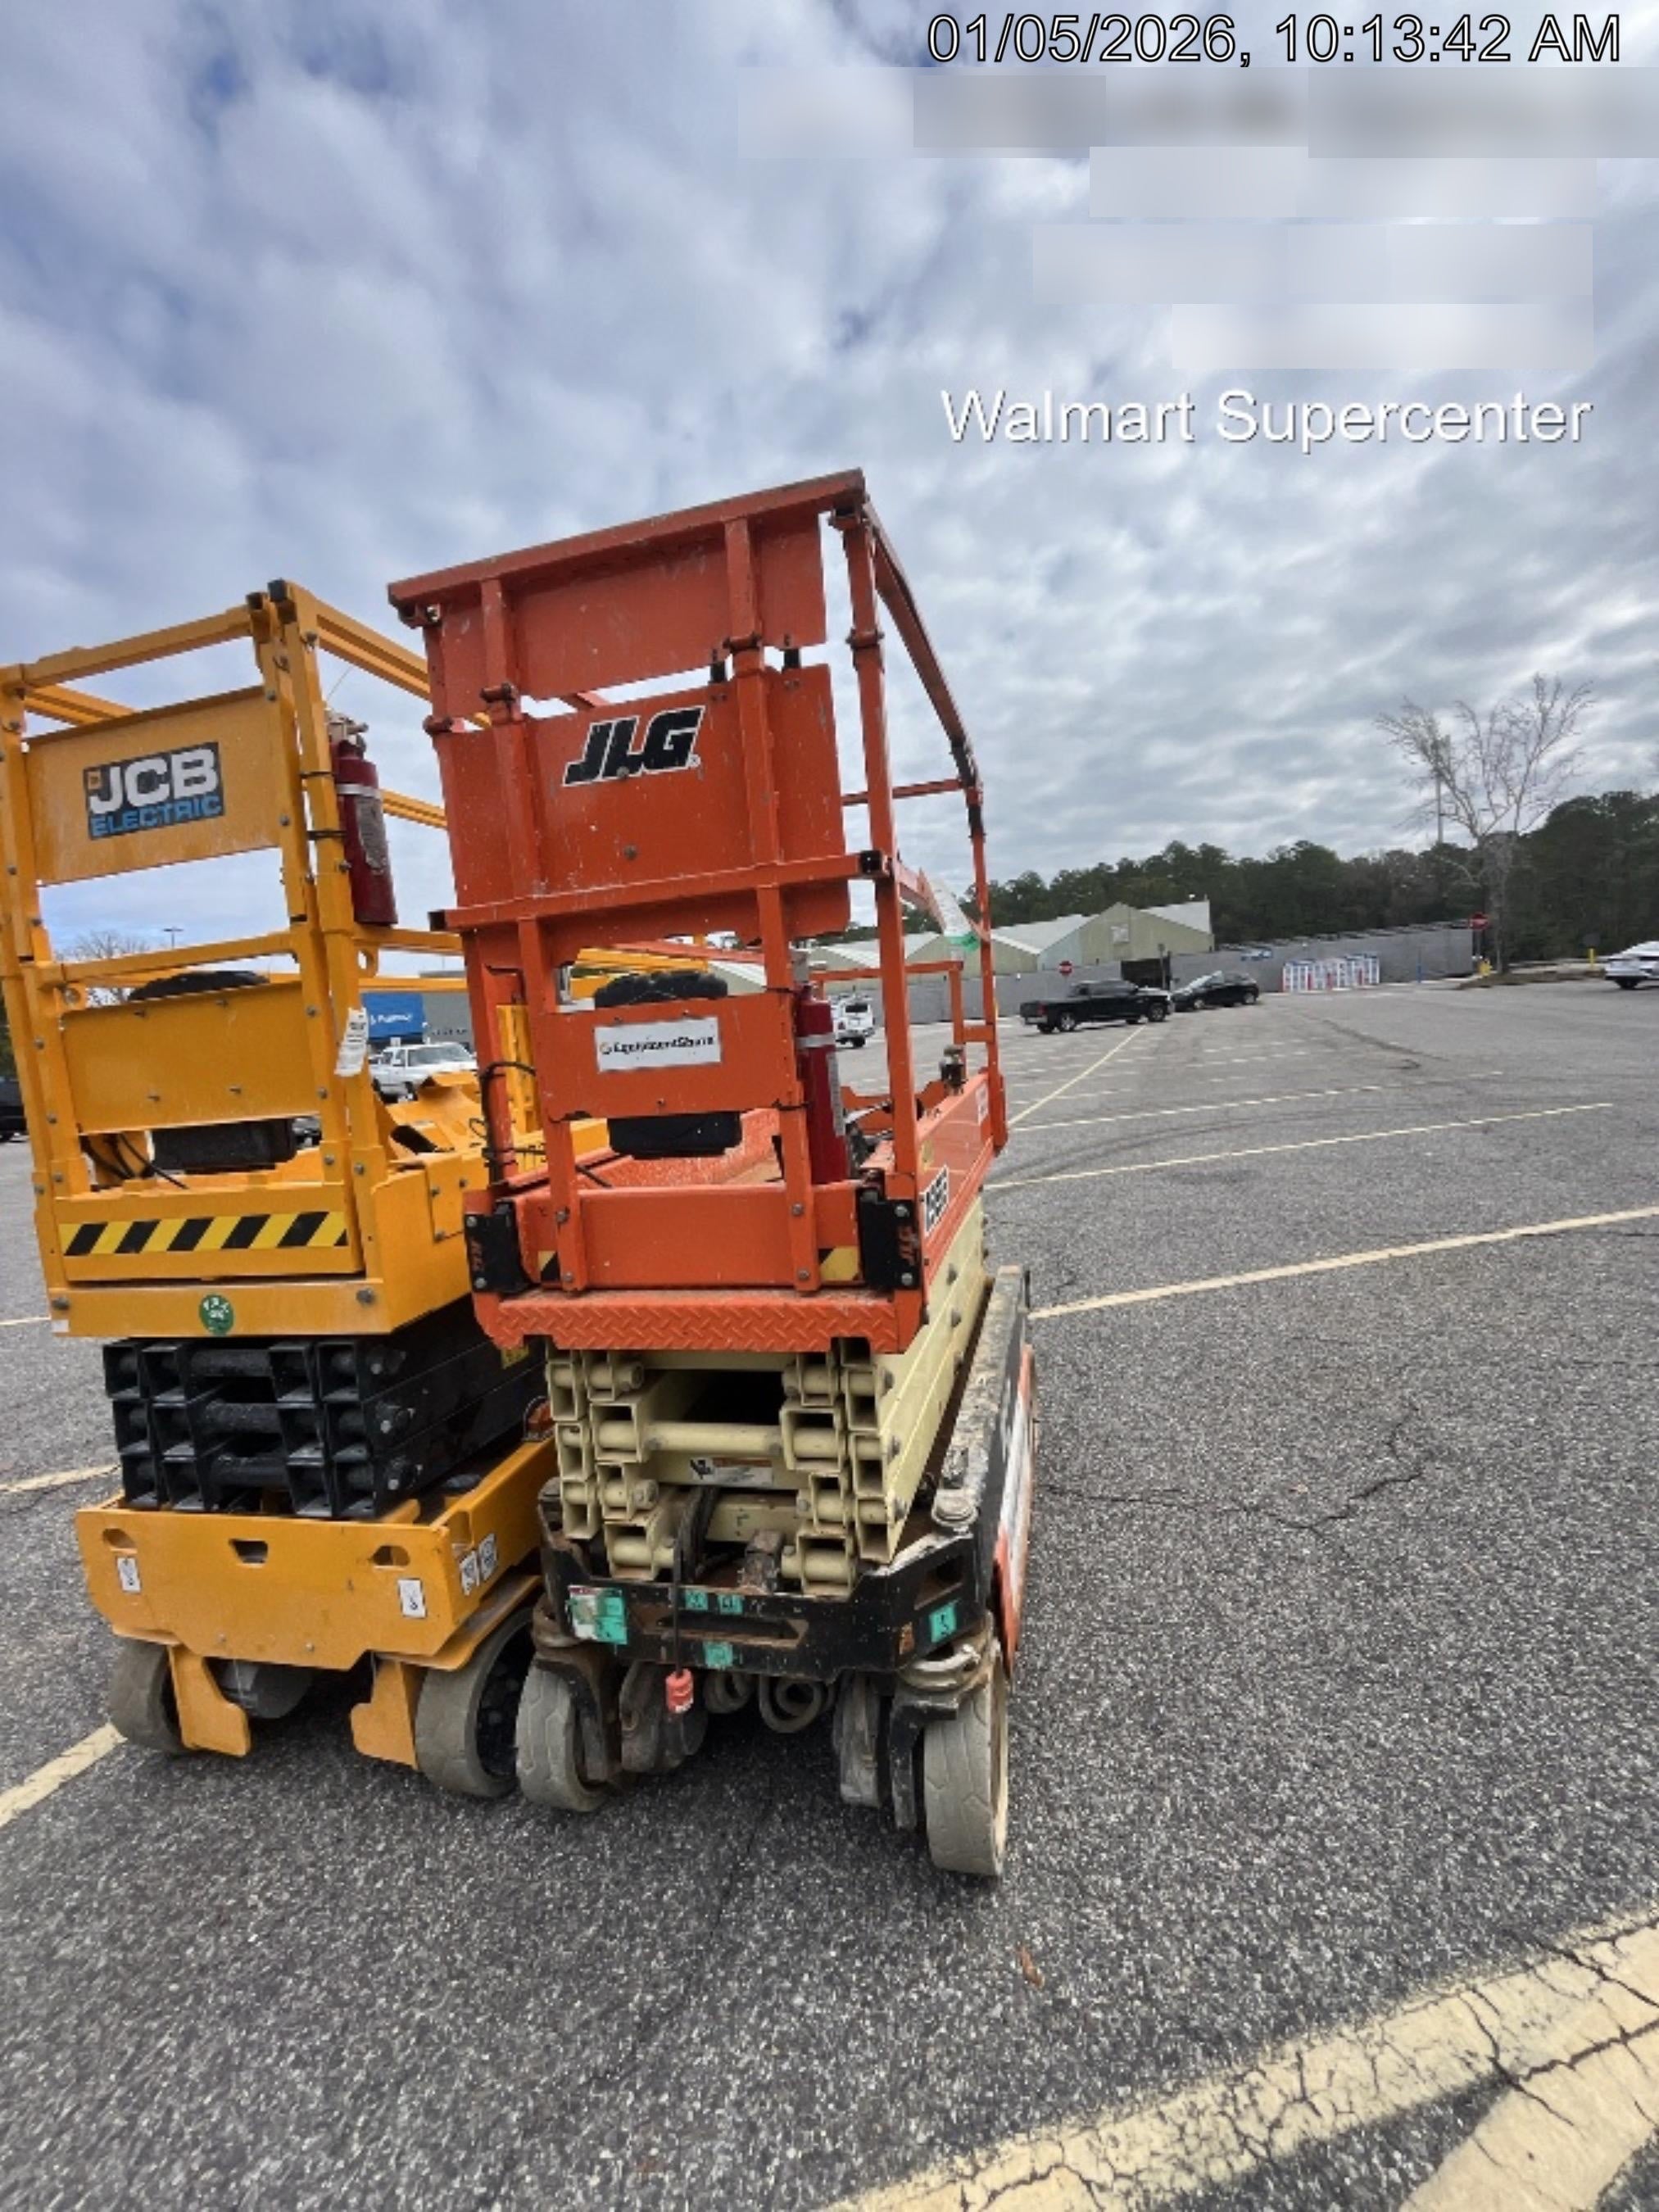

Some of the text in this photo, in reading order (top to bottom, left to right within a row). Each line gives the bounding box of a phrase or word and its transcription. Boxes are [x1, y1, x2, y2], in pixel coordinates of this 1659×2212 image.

[563, 705, 706, 786] JLG
[89, 749, 219, 814] JCB
[90, 796, 222, 837] ELECTRIC
